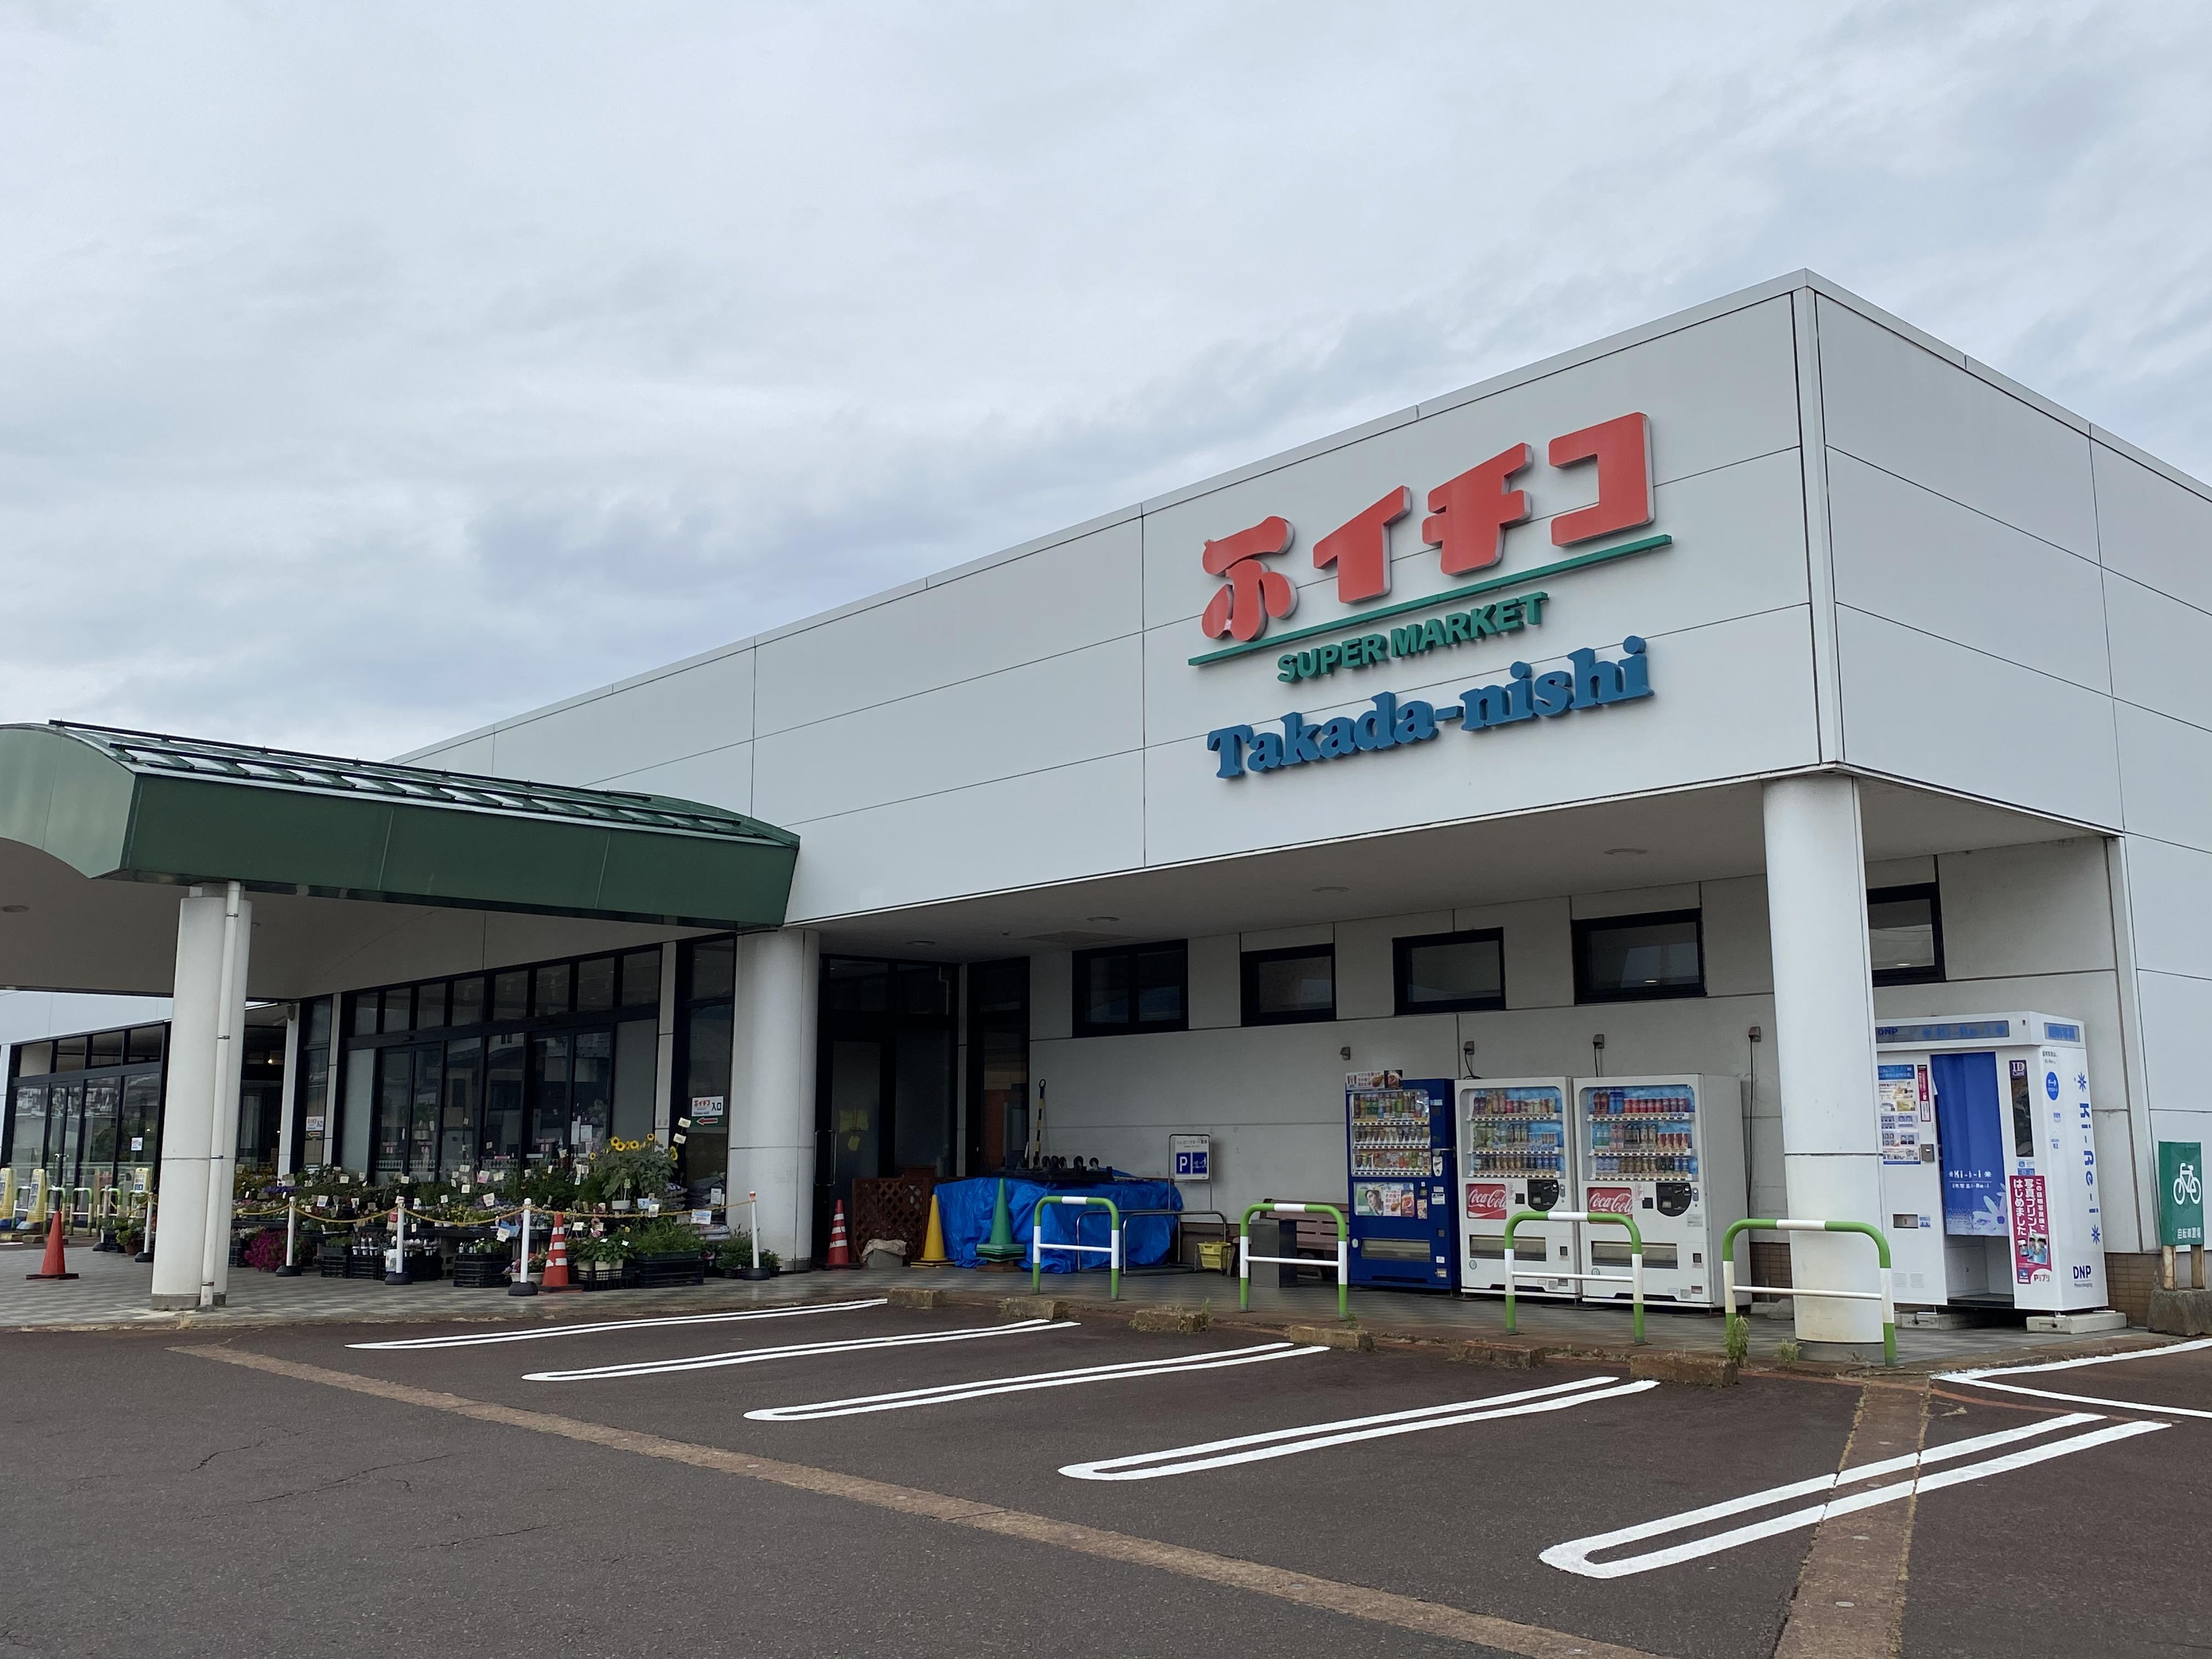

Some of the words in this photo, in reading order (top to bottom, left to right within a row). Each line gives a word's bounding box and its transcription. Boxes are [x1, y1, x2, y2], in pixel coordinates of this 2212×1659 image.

[1277, 633, 1388, 683] SUPER
[1390, 591, 1550, 658] MARKET
[1207, 635, 1655, 780] Takada-nishi
[1877, 1028, 1898, 1036] DNP
[2012, 1062, 2025, 1072] ID
[712, 1102, 721, 1111] 入口
[1180, 1156, 1188, 1172] P
[2079, 1102, 2099, 1214] Ki-Re-i
[2013, 1178, 2027, 1236] はじめました
[2024, 1178, 2037, 1235] 写真プリント
[2073, 1265, 2091, 1279] DNP
